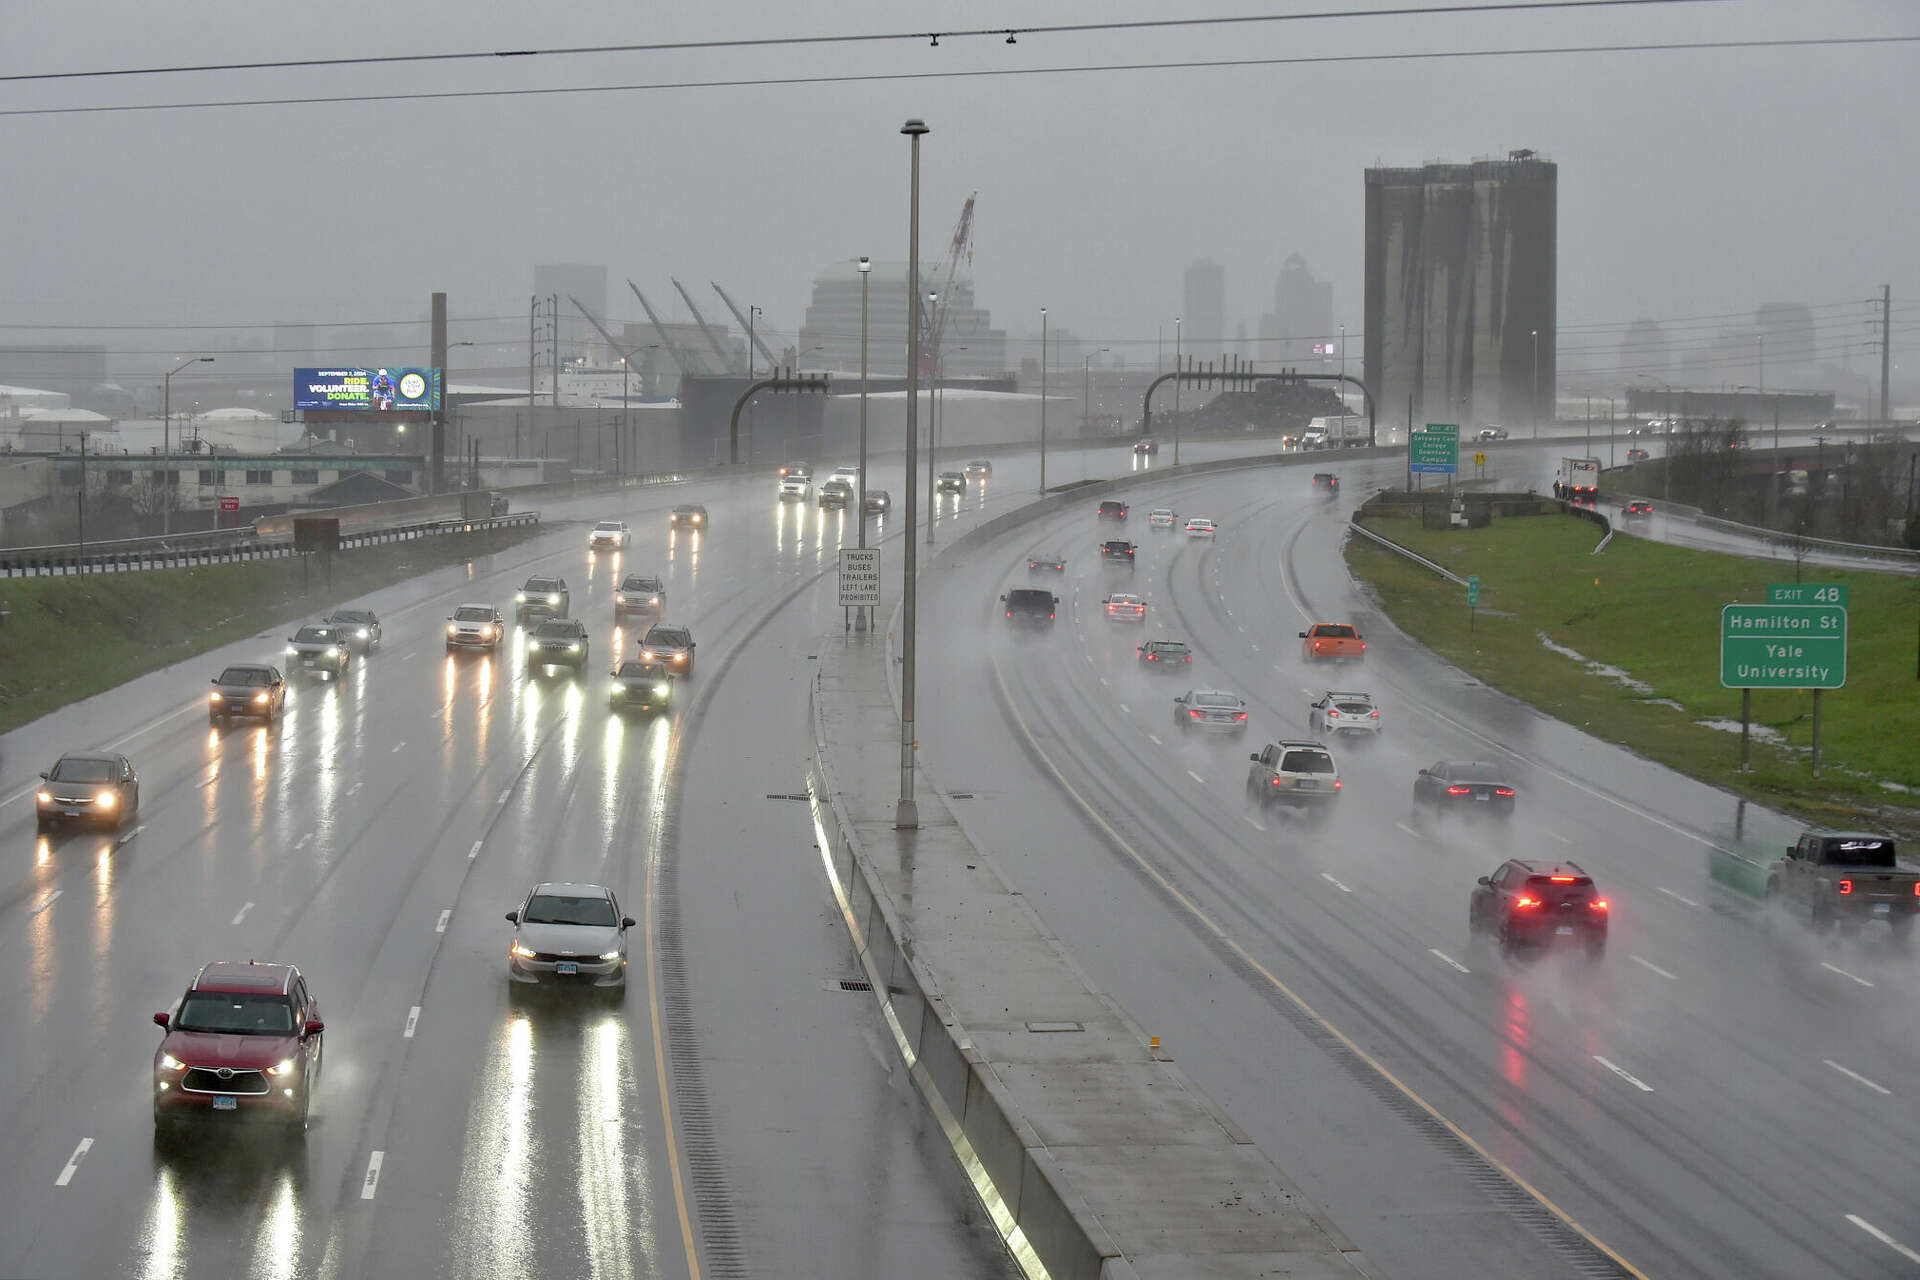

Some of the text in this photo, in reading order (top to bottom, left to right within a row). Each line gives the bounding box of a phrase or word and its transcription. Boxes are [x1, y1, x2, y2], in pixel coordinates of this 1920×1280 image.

[344, 377, 369, 385] RIDE.
[309, 384, 370, 393] VOLUNTEER.
[327, 392, 370, 400] DONATE.
[1573, 463, 1596, 471] FedEx
[847, 553, 873, 561] TRUCKS
[847, 563, 872, 571] BUSES
[842, 573, 878, 581] TRAILERS
[842, 583, 877, 591] LEFT LANE
[840, 593, 879, 601] PROHIBITED
[1775, 587, 1839, 602] EXIT 48
[1730, 615, 1838, 629] Hamilton St
[1766, 644, 1803, 657] Yale
[1737, 664, 1829, 681] University
